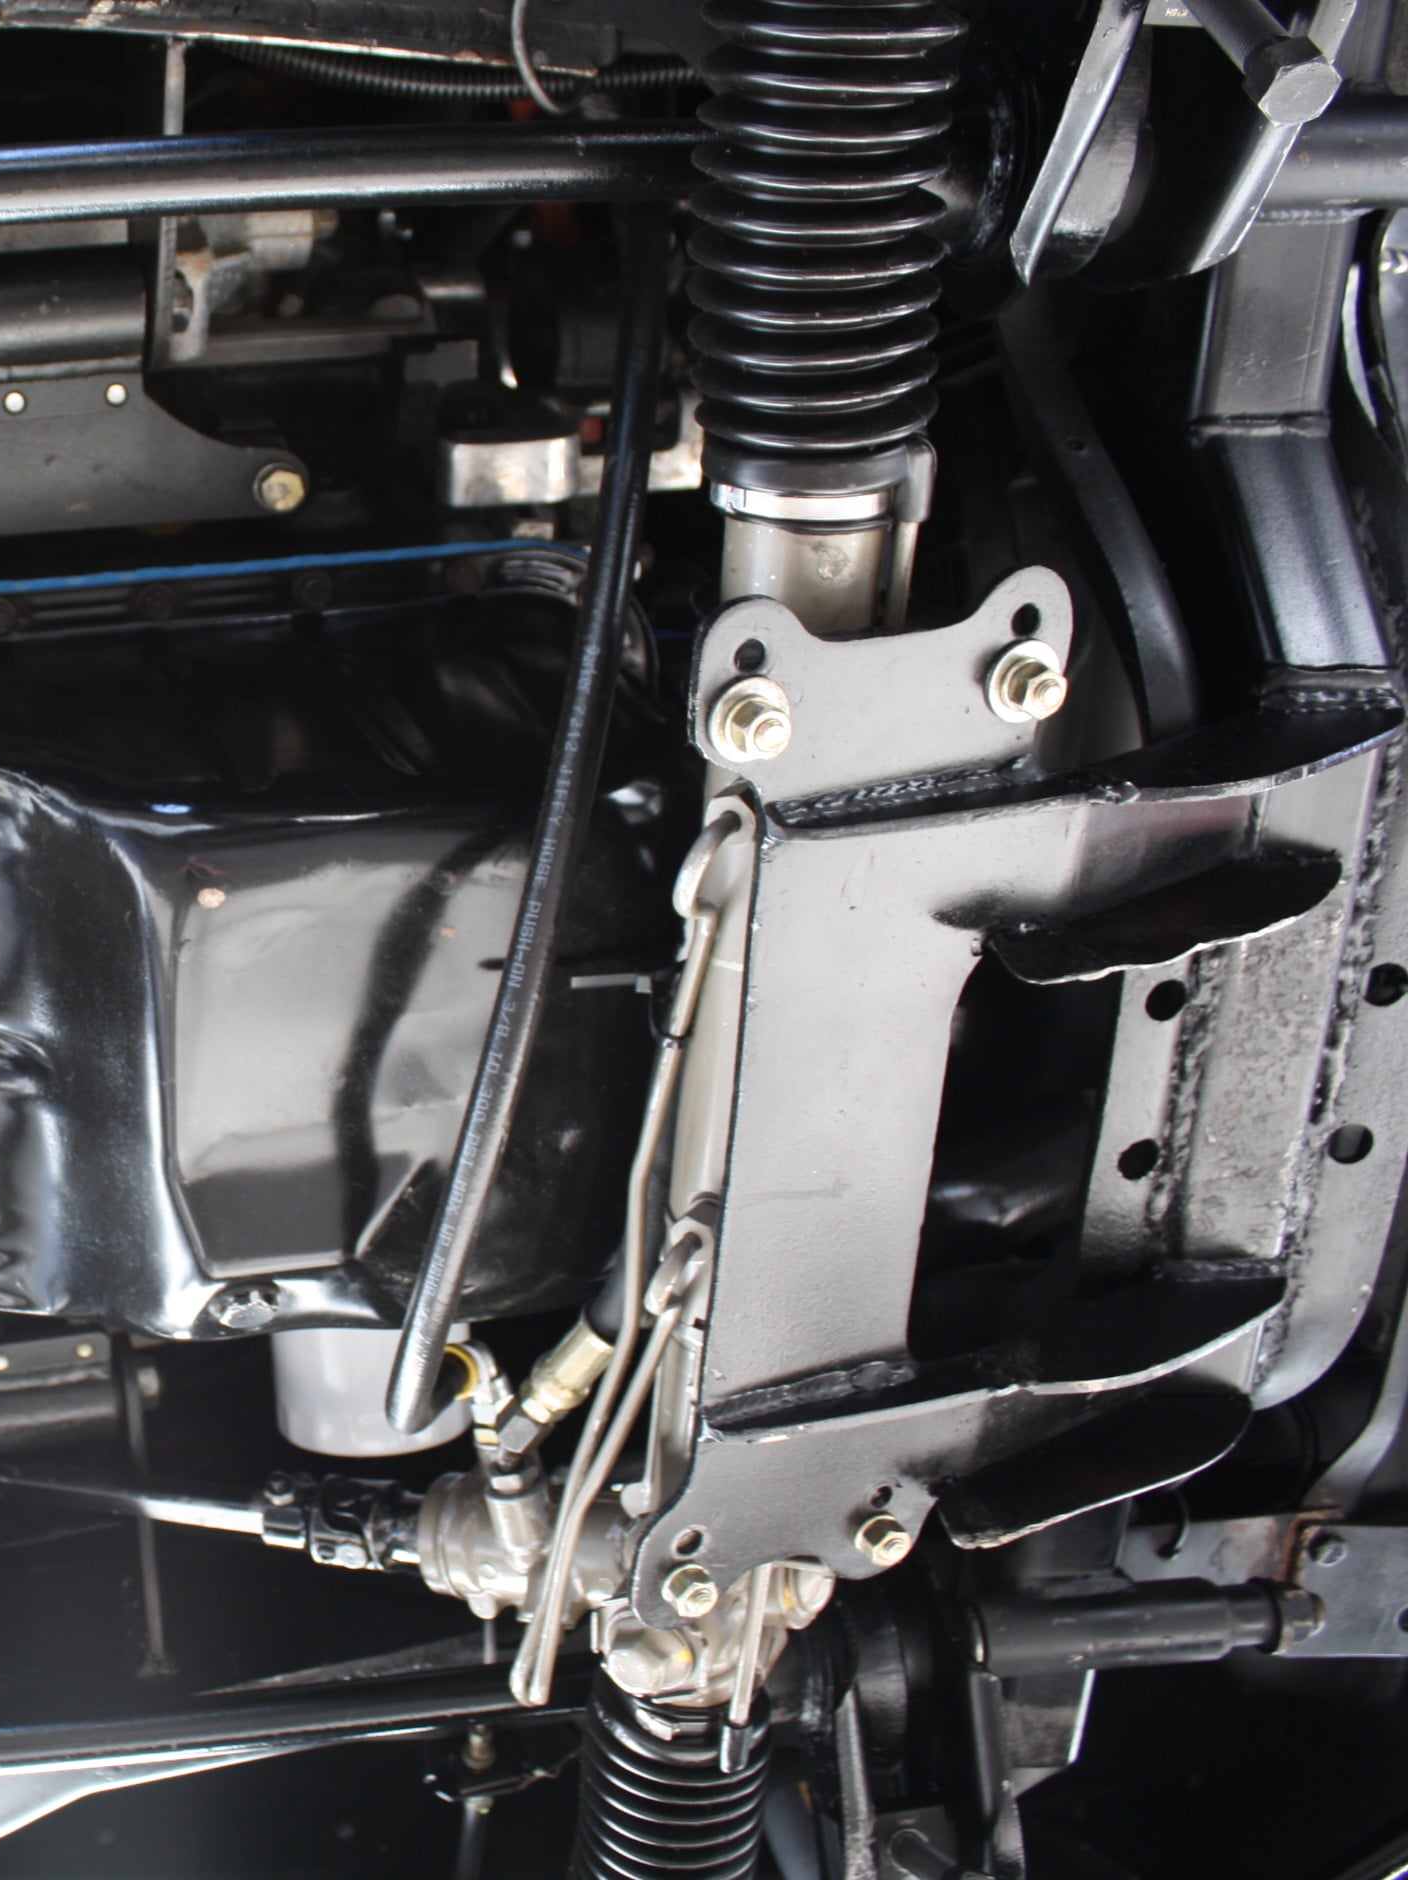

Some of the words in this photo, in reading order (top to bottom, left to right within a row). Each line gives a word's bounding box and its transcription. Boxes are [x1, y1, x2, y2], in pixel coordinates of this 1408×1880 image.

[548, 764, 573, 826] JIFFY
[532, 838, 557, 888] HOSE
[507, 899, 542, 989] PUSH-ON
